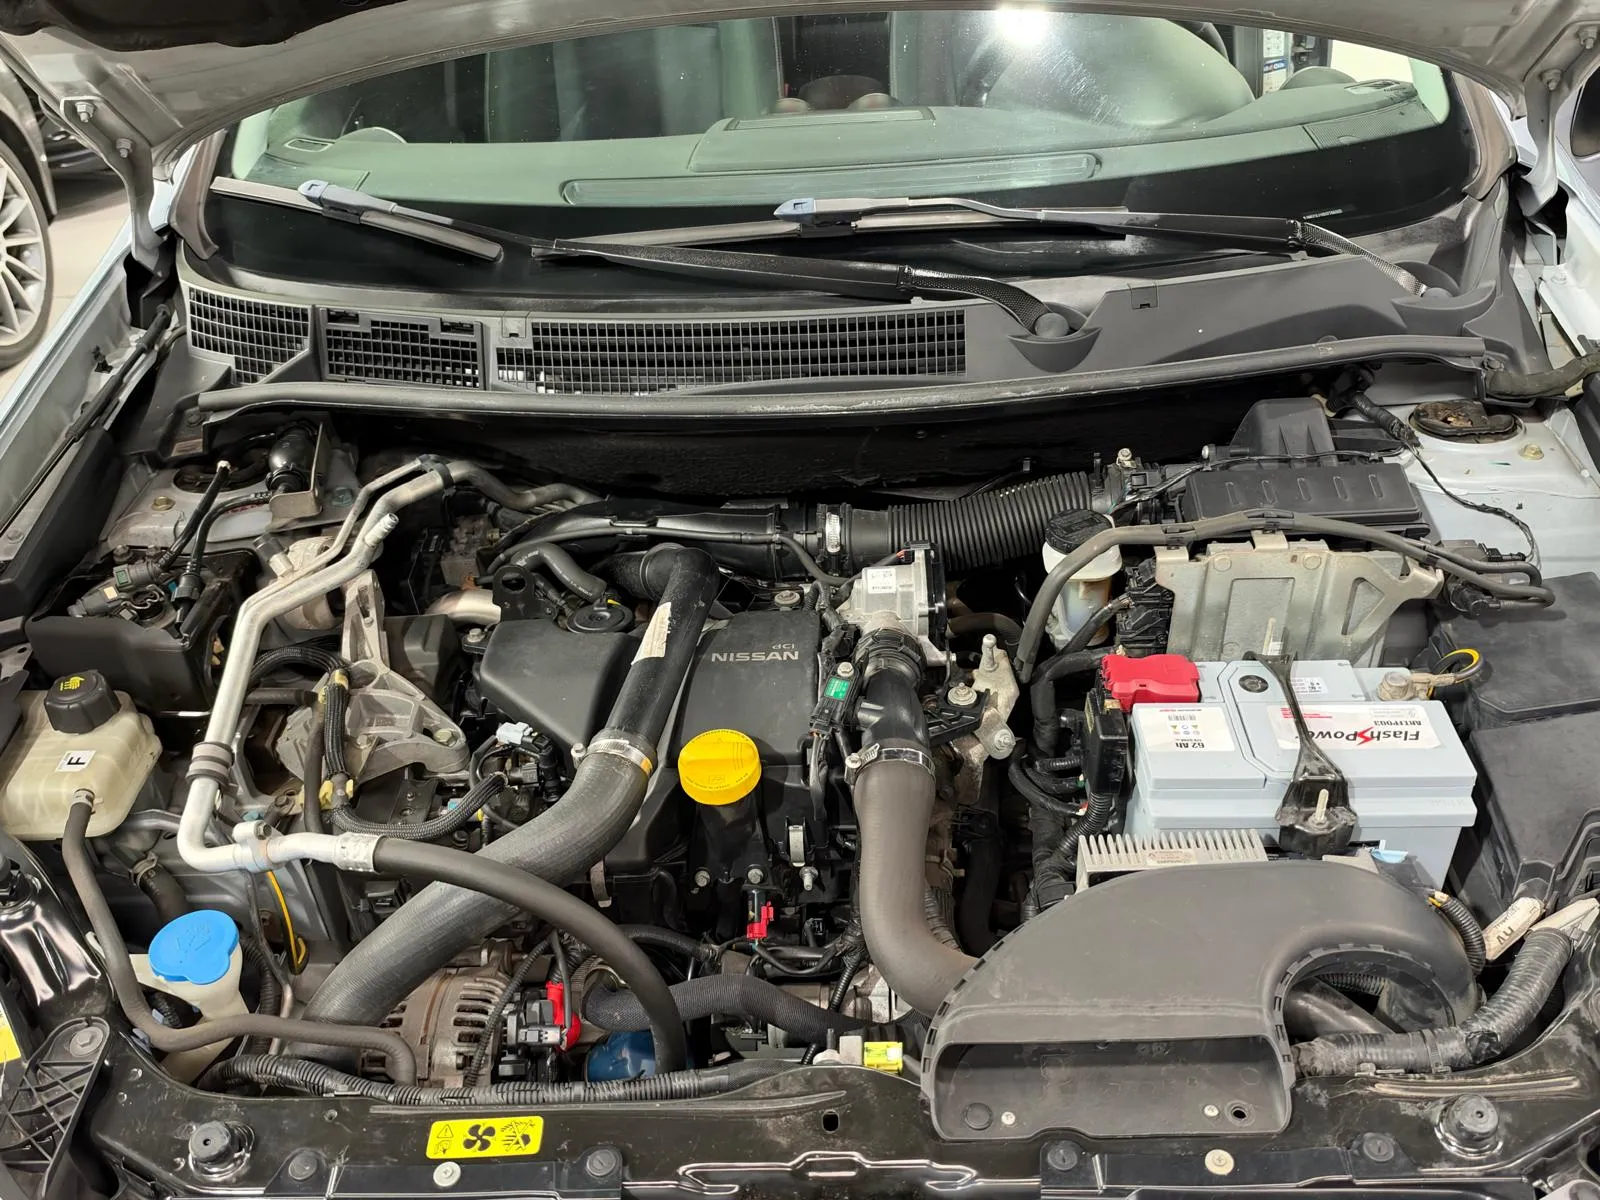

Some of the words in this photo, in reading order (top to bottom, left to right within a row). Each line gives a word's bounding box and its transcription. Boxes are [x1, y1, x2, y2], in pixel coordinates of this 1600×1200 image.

[711, 650, 799, 662] NISSAN
[1370, 730, 1420, 741] Flash
[66, 756, 86, 765] F
